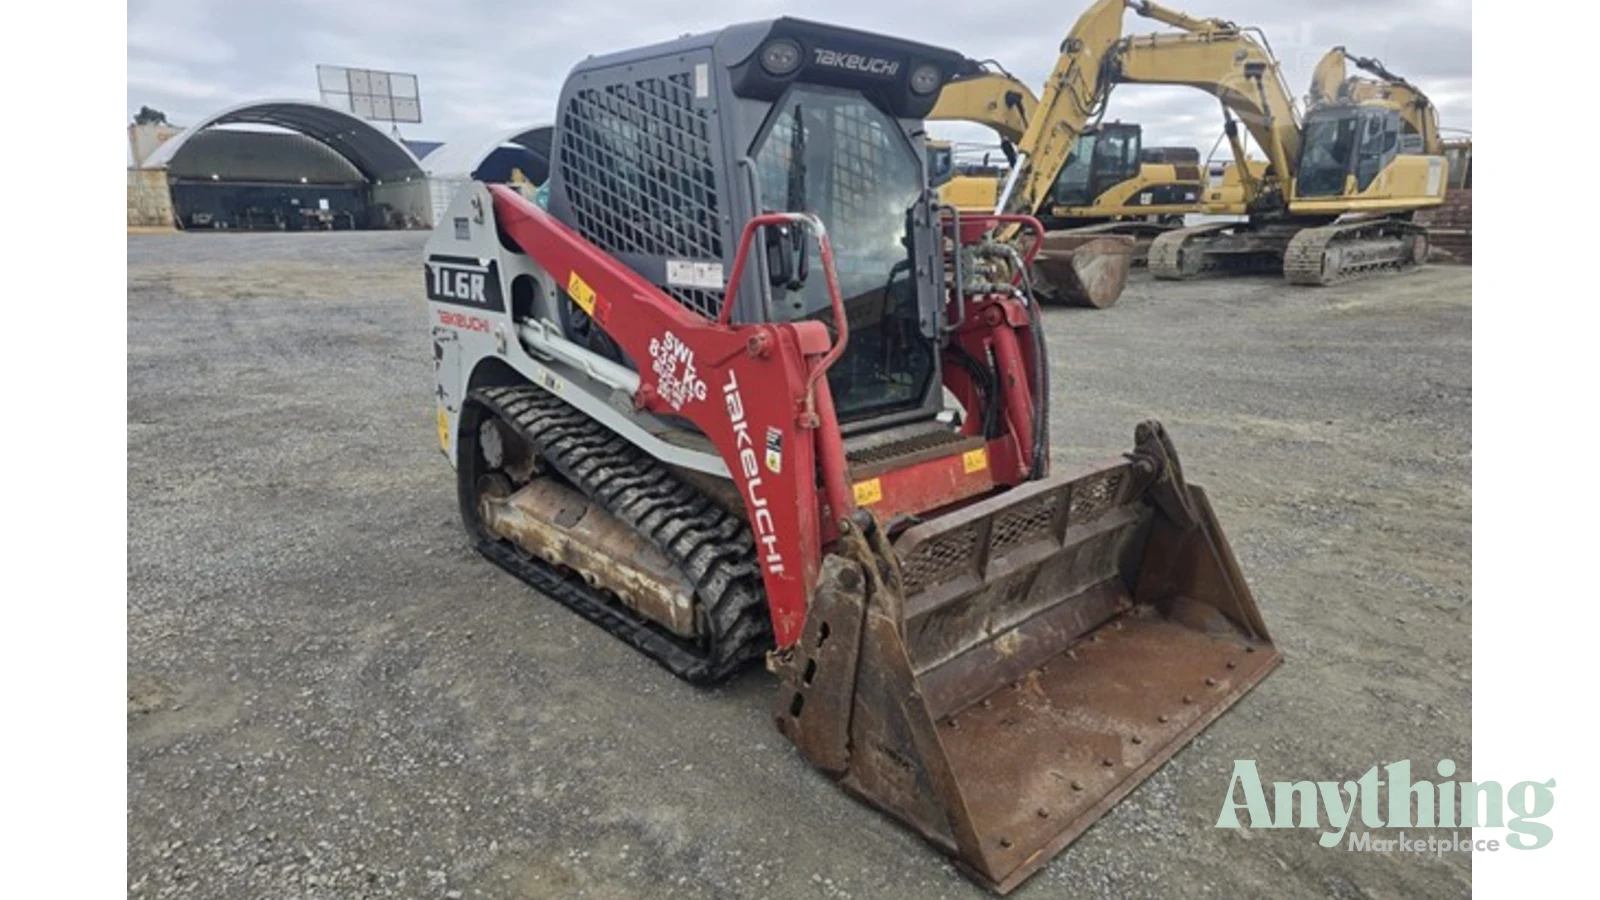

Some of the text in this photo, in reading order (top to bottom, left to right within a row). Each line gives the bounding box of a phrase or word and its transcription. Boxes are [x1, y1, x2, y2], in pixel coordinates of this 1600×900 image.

[429, 261, 489, 303] TL6R
[663, 330, 697, 374] SWL
[682, 367, 708, 402] KG
